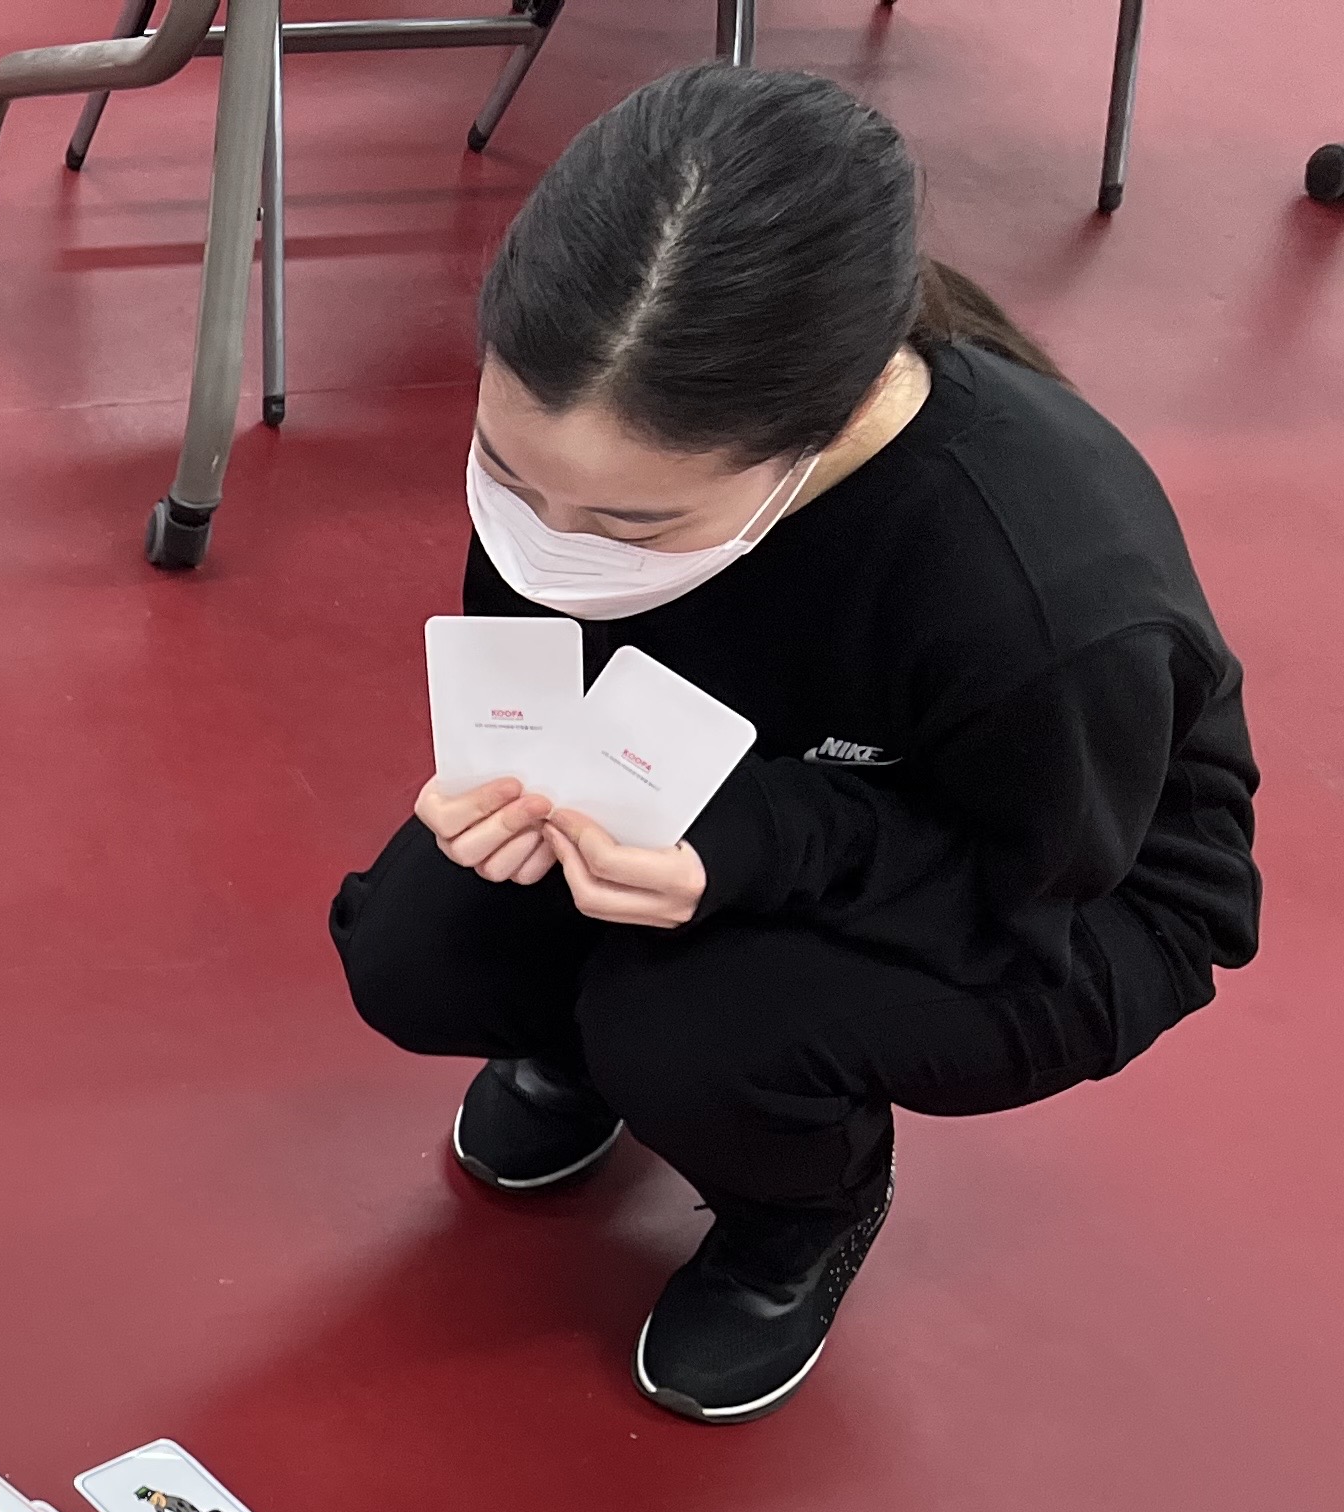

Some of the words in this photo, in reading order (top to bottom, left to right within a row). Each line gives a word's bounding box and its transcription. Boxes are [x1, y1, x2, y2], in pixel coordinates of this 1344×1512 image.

[491, 709, 524, 718] KOOFA
[622, 748, 652, 771] KOOFA
[819, 737, 883, 762] NIKE
